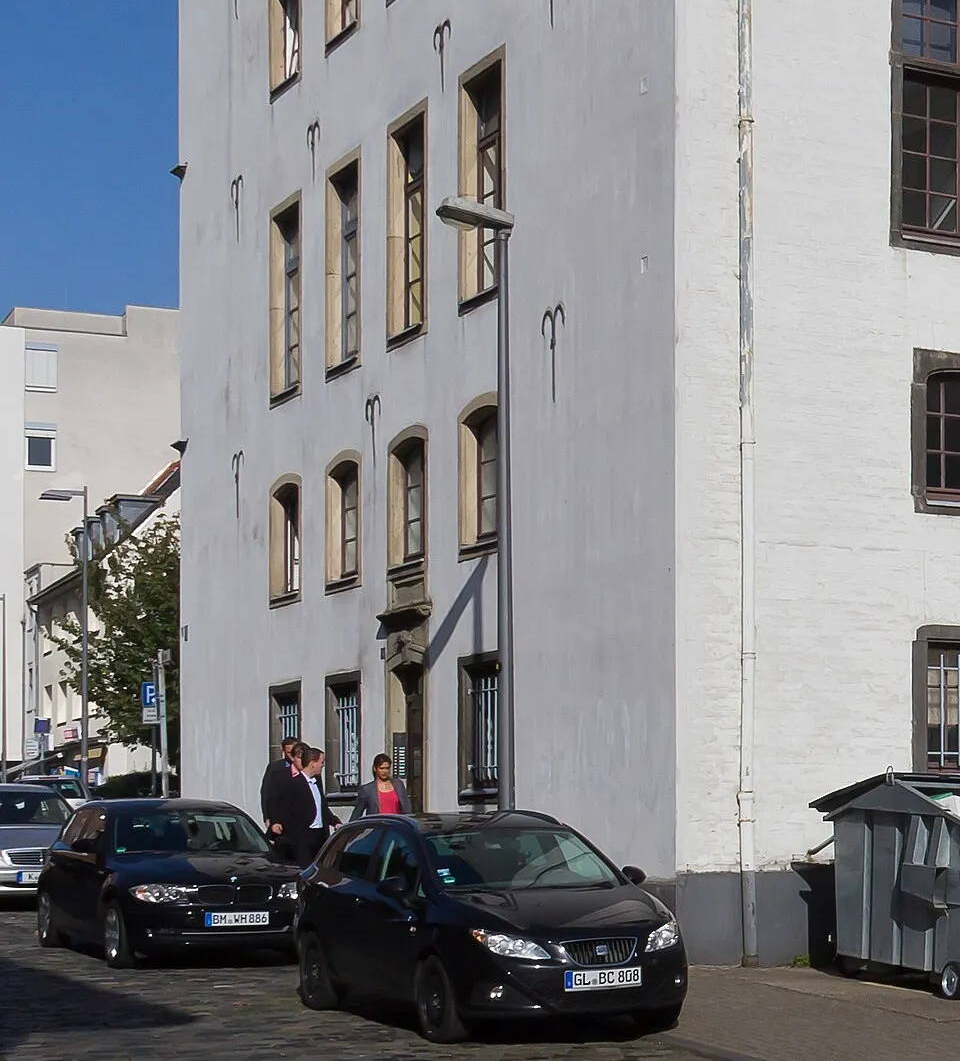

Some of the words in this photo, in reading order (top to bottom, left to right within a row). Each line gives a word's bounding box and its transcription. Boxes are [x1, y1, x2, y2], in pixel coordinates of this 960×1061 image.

[213, 914, 227, 924] BM
[234, 914, 247, 924] WH
[574, 973, 591, 986] GL
[599, 971, 614, 984] BC
[618, 969, 639, 983] 808
